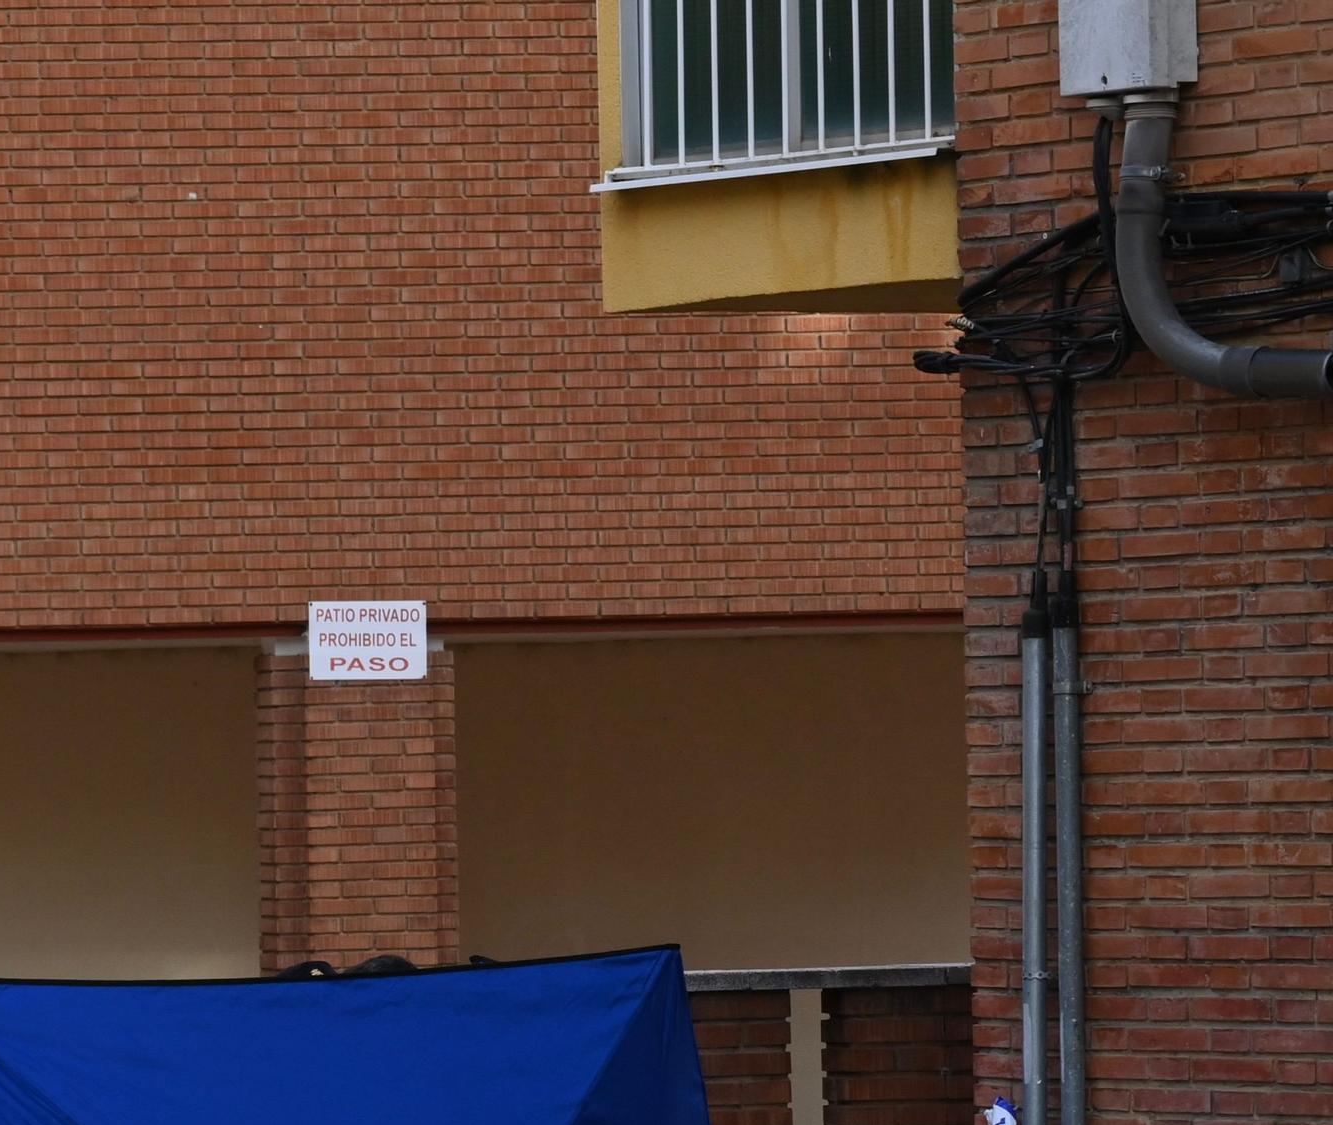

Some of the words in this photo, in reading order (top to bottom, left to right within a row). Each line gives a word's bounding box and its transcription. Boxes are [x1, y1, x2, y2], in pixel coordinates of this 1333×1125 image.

[316, 608, 355, 623] PATIO
[359, 608, 420, 623] PRIVADO
[319, 632, 396, 647] PROHIBIDO
[400, 632, 417, 647] EL
[330, 657, 409, 671] PASO
